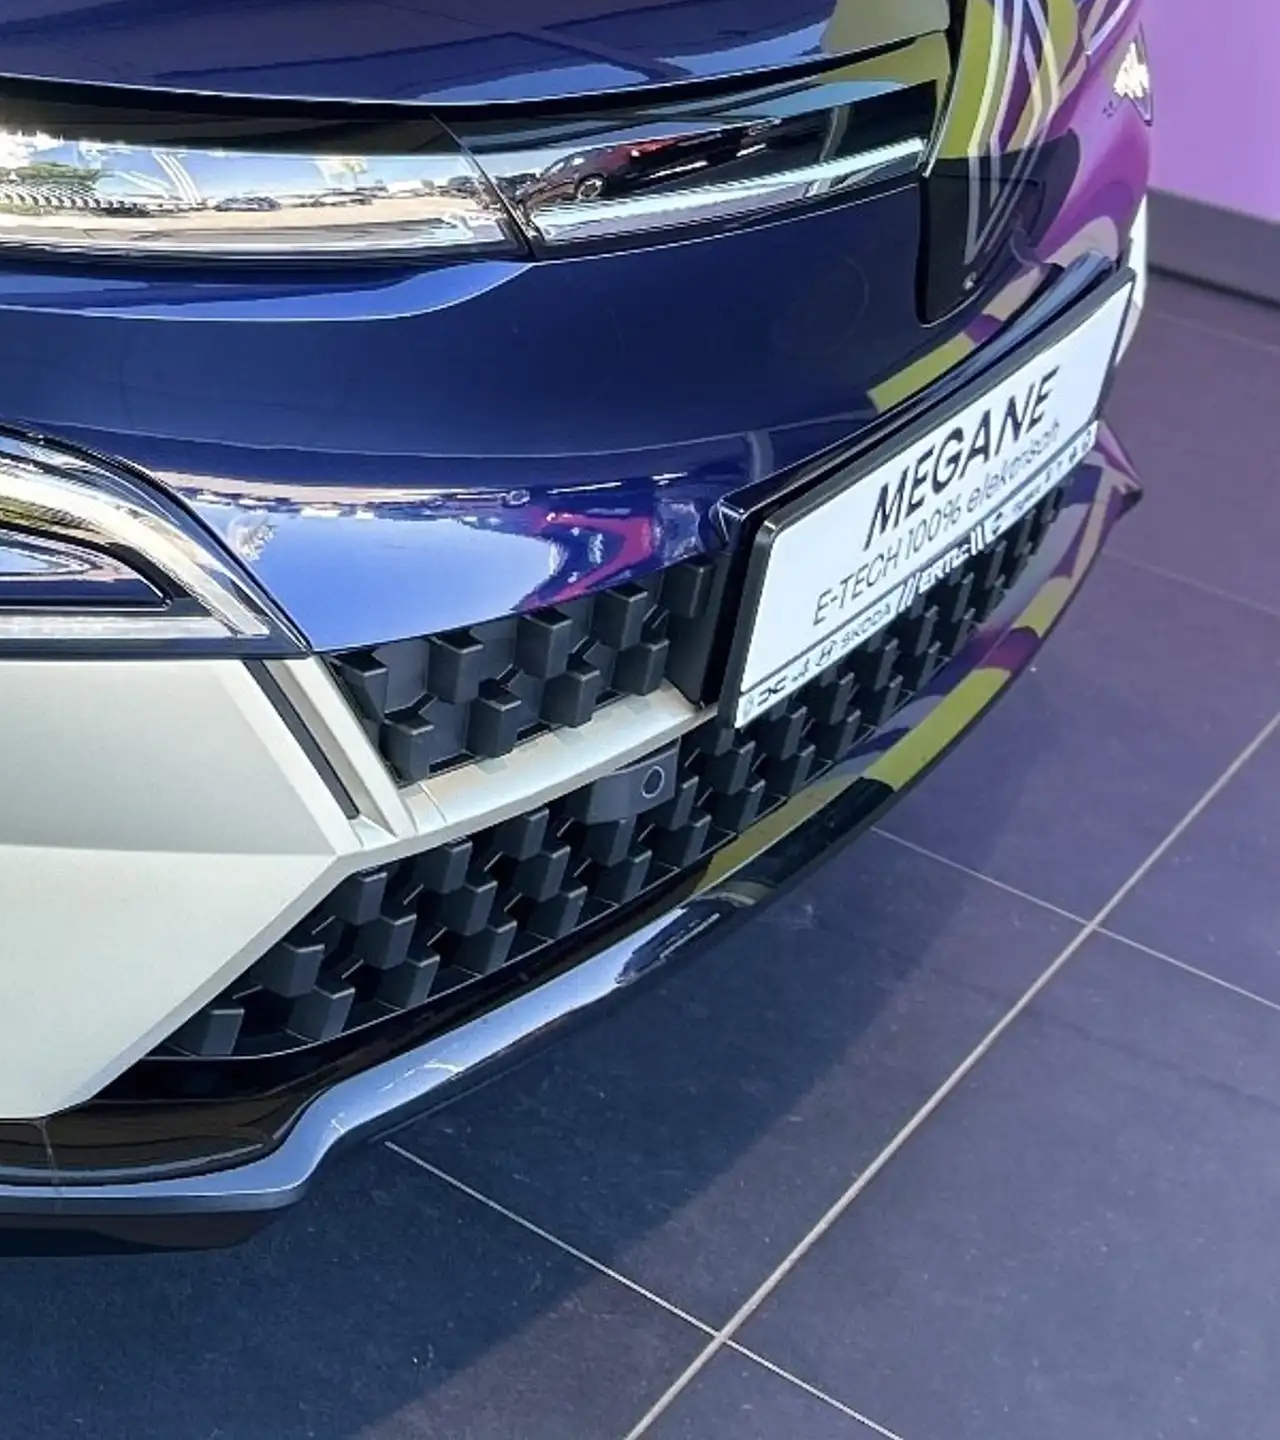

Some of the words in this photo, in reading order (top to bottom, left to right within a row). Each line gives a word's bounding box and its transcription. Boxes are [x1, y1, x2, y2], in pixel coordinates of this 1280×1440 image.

[863, 365, 1060, 551] MEGANE
[812, 536, 902, 626] E-TECH
[905, 492, 962, 560] 100%
